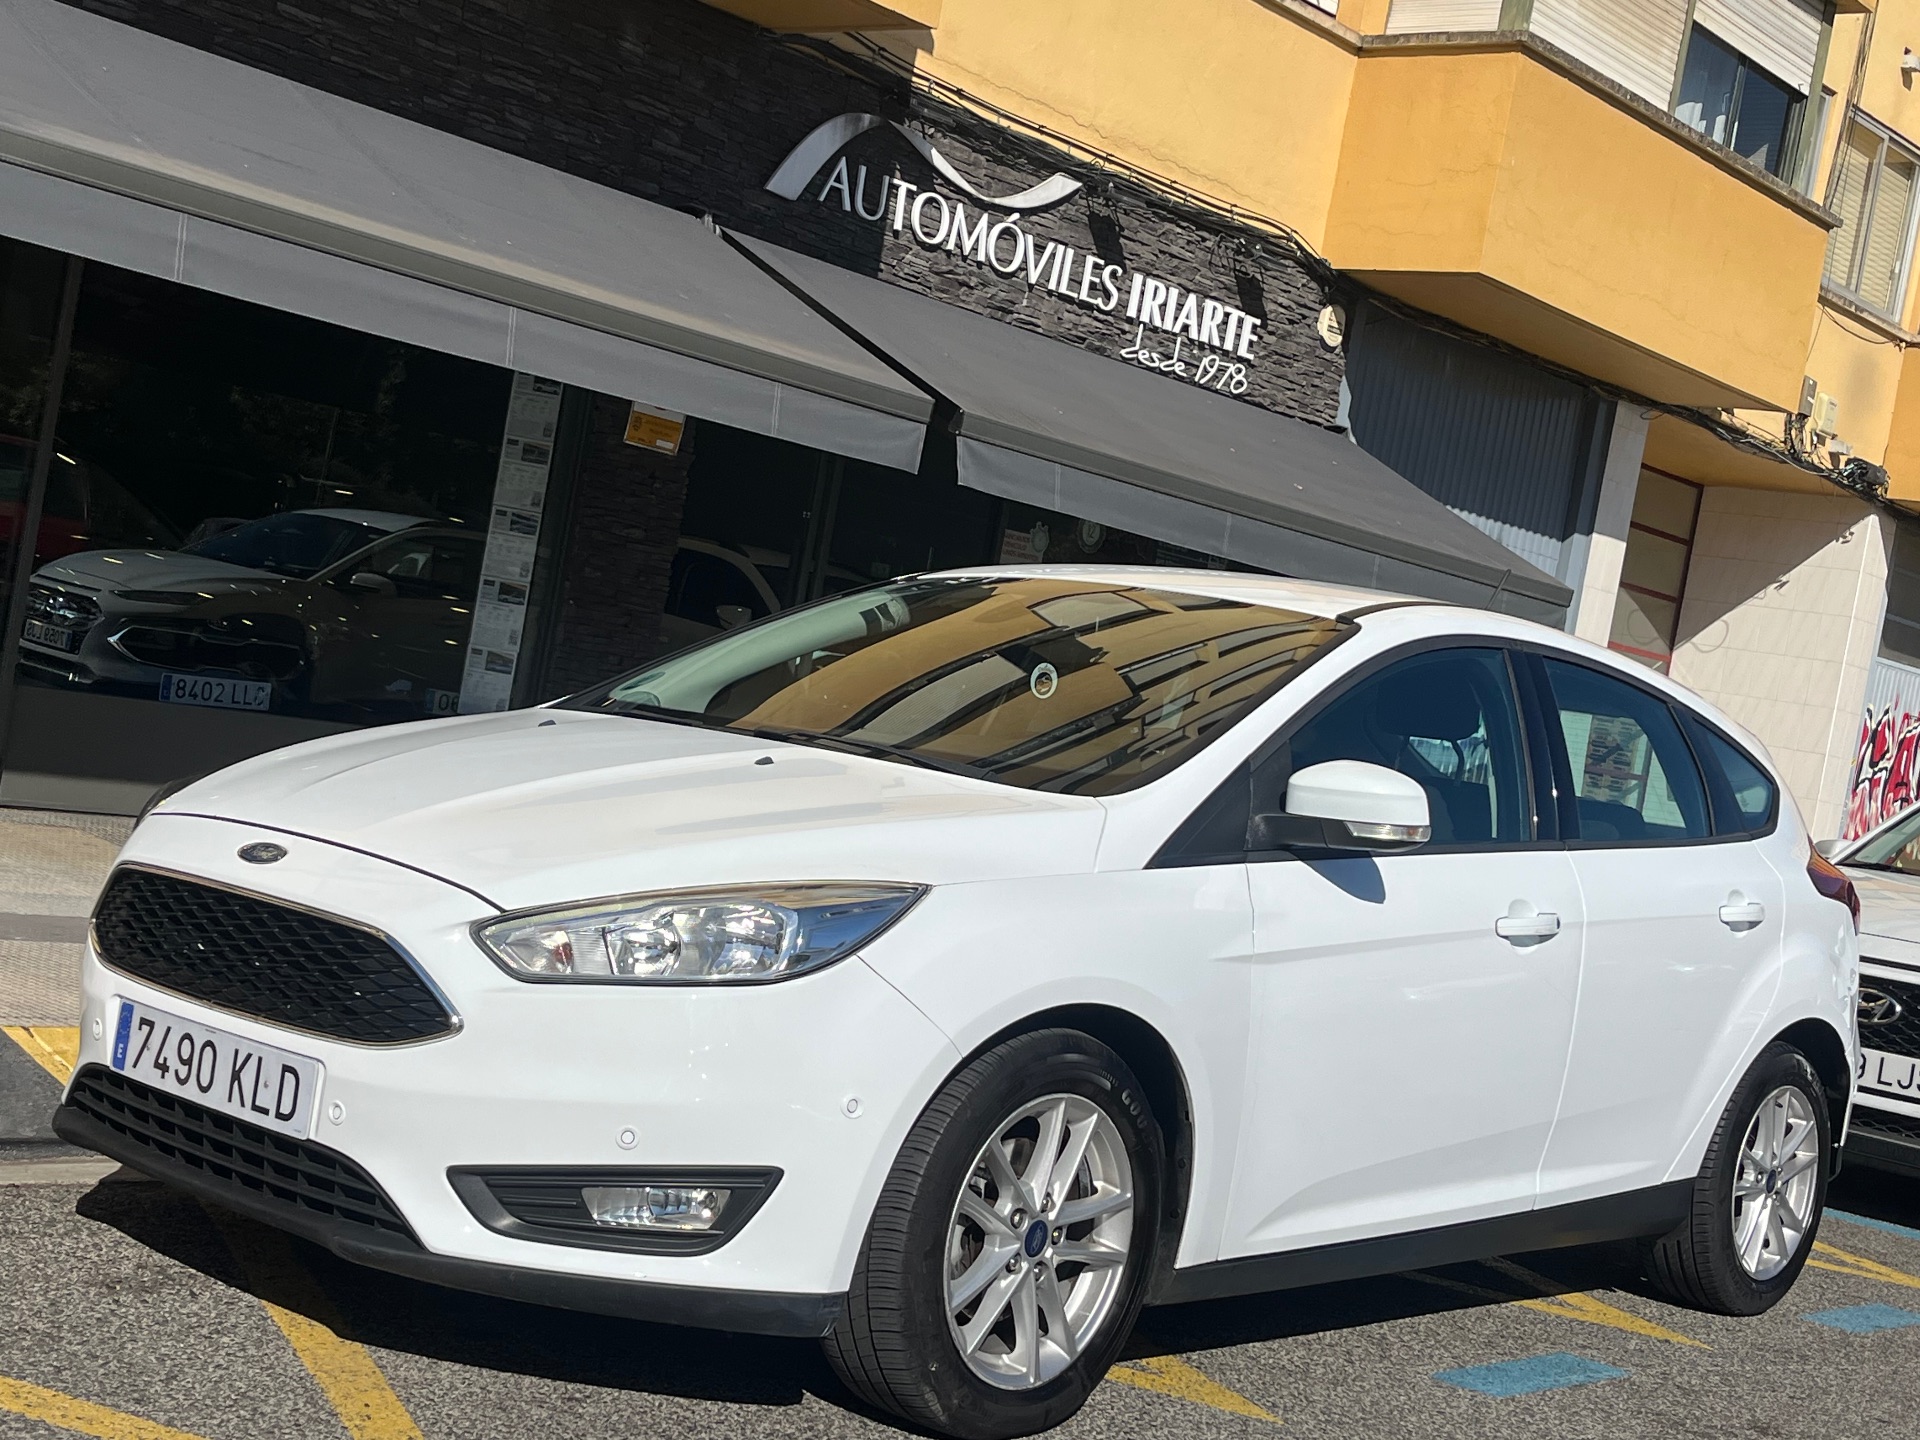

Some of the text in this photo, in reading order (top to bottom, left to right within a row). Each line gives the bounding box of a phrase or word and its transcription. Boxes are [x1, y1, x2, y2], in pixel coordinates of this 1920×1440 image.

[818, 155, 1262, 361] AUTOMÓVILES IRIARTE
[1119, 323, 1248, 395] desde 1978
[175, 678, 225, 703] 8402
[117, 1016, 300, 1122] E 7490 KLD
[1877, 1057, 1920, 1092] LJ
